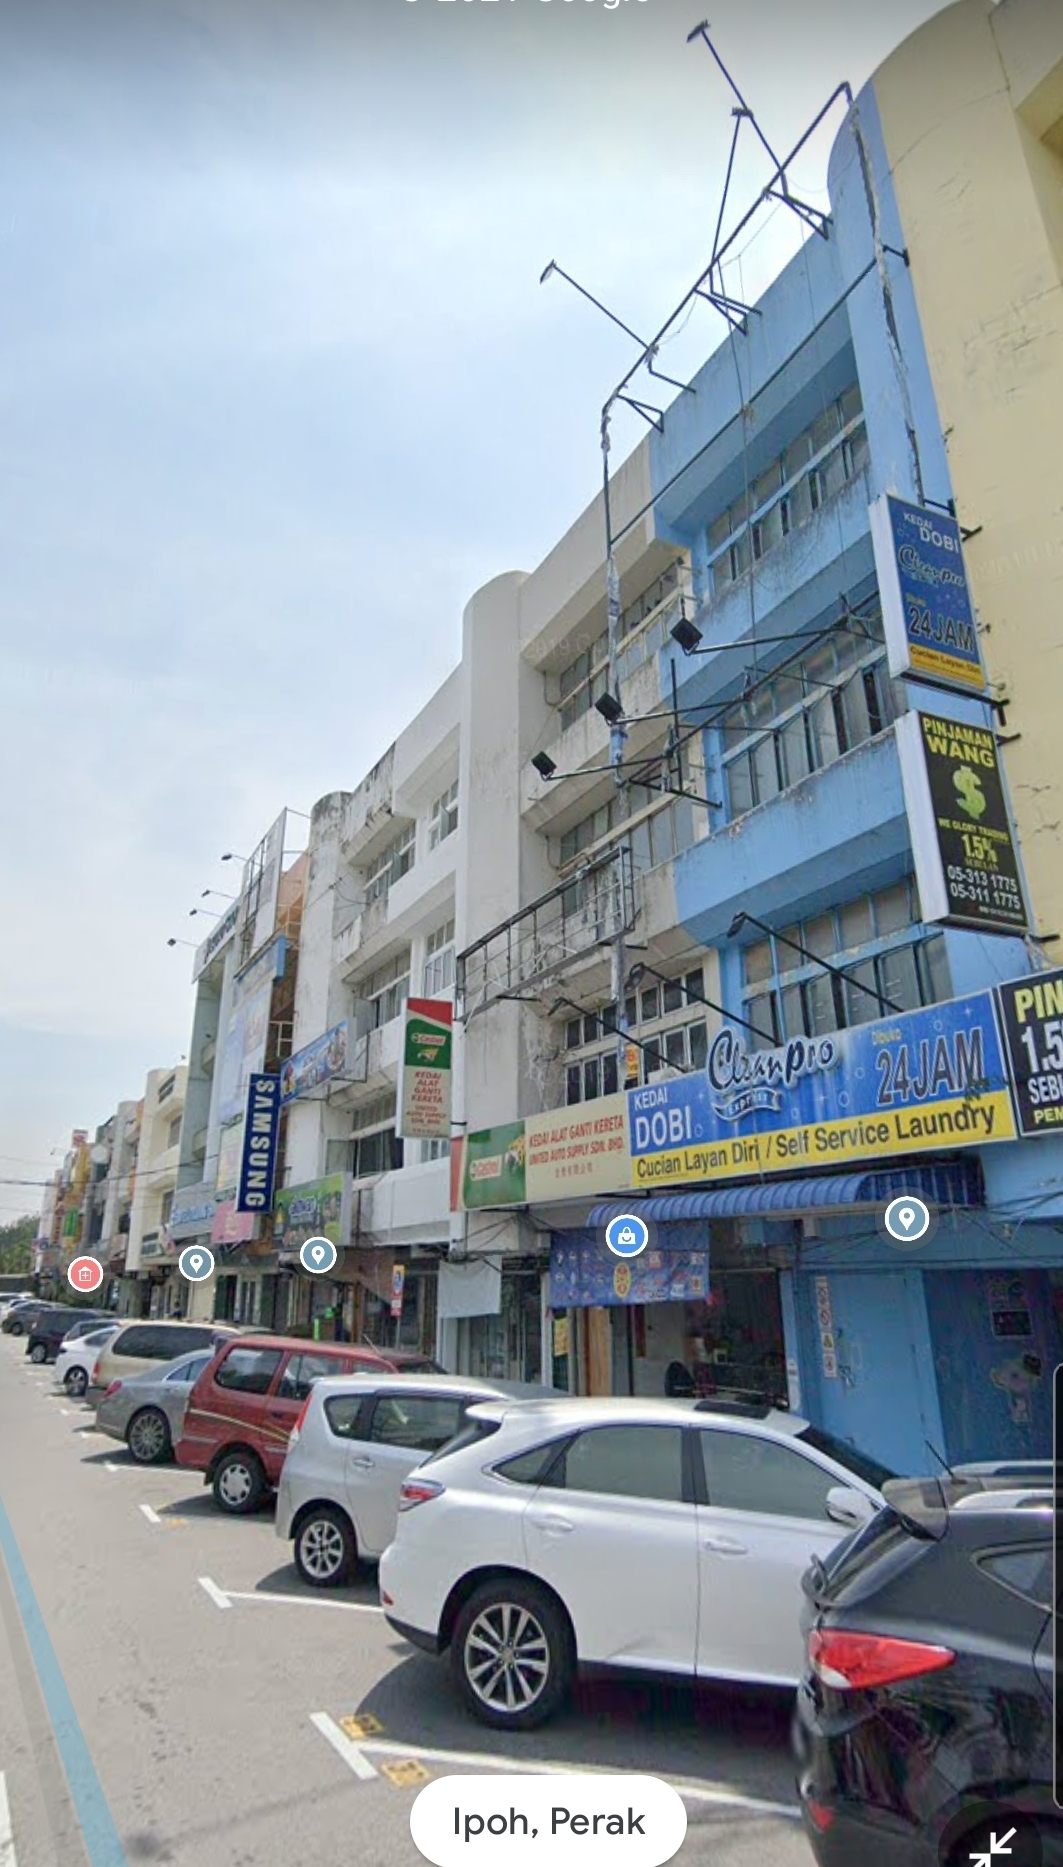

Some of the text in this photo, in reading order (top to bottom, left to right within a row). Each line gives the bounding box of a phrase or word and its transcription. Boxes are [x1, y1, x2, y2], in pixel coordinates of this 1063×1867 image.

[904, 513, 933, 529] KEDAI
[919, 527, 960, 553] DOBI
[923, 716, 993, 749] PINJAMAN
[926, 734, 995, 768] WANG
[962, 833, 998, 863] 1.5%
[947, 864, 1018, 892] 05-313 1775
[950, 882, 1021, 910] 05-311 1775
[1021, 1020, 1063, 1073] 1.5
[634, 1087, 668, 1110] KEDAI
[529, 1114, 623, 1148] KEDAI ALAT GANTI KERETA
[635, 1105, 692, 1149] DOBI
[637, 1155, 681, 1179] Cucian
[684, 1149, 727, 1175] Layan
[732, 1138, 760, 1163] Diri
[776, 1131, 810, 1158] Self
[814, 1121, 889, 1151] Service
[895, 1104, 995, 1139] Laundry
[245, 1080, 276, 1207] SAMSUNG
[567, 1143, 589, 1158] SUPPLY
